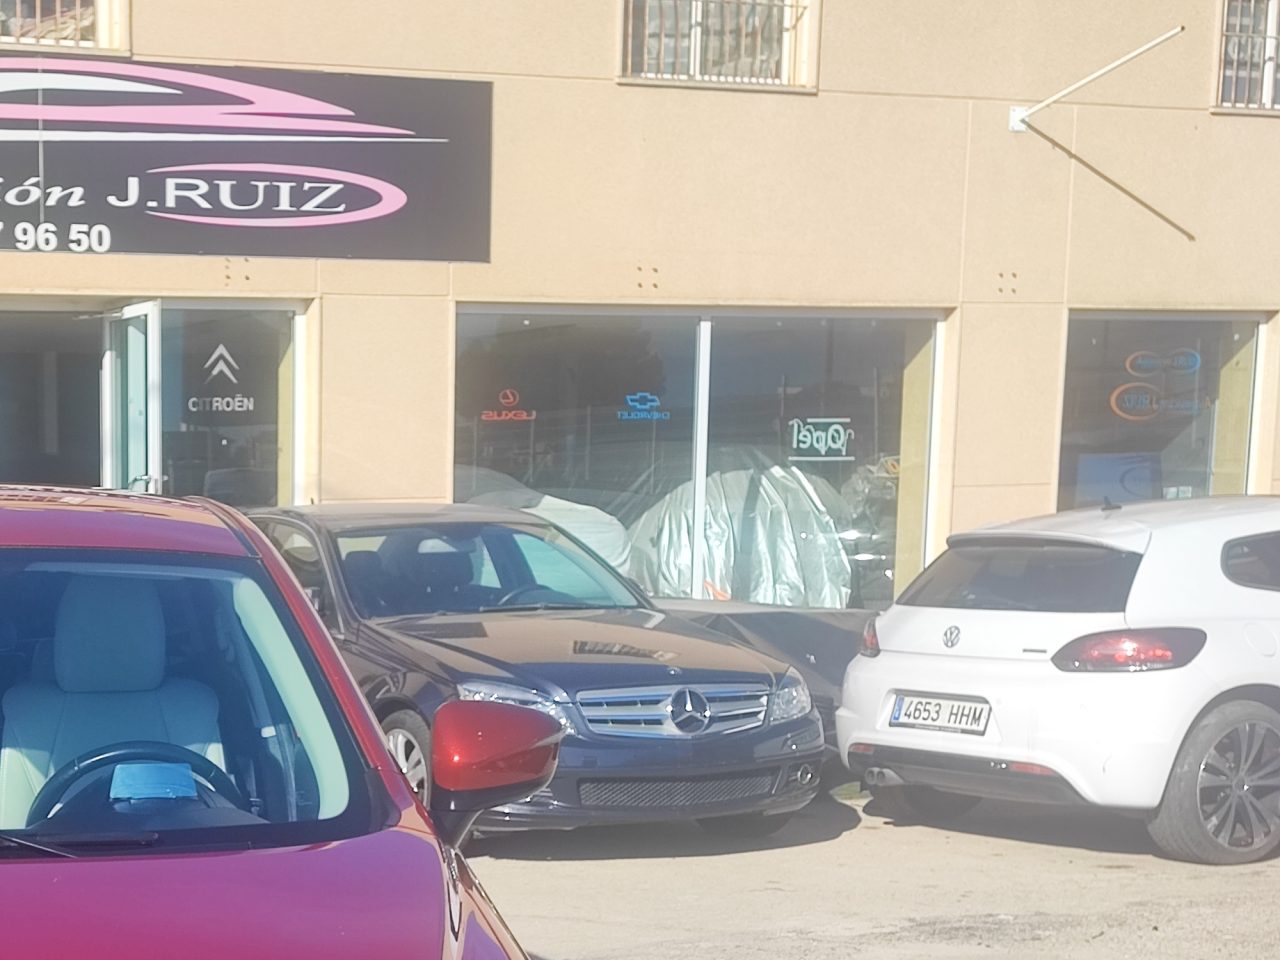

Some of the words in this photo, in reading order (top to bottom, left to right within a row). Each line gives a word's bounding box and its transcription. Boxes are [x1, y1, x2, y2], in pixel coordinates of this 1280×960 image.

[106, 175, 346, 213] J.RUIZ
[14, 221, 58, 252] 96
[68, 223, 112, 253] 50
[187, 393, 255, 412] CITROËN
[904, 699, 942, 723] 4653
[947, 703, 984, 728] HHM
